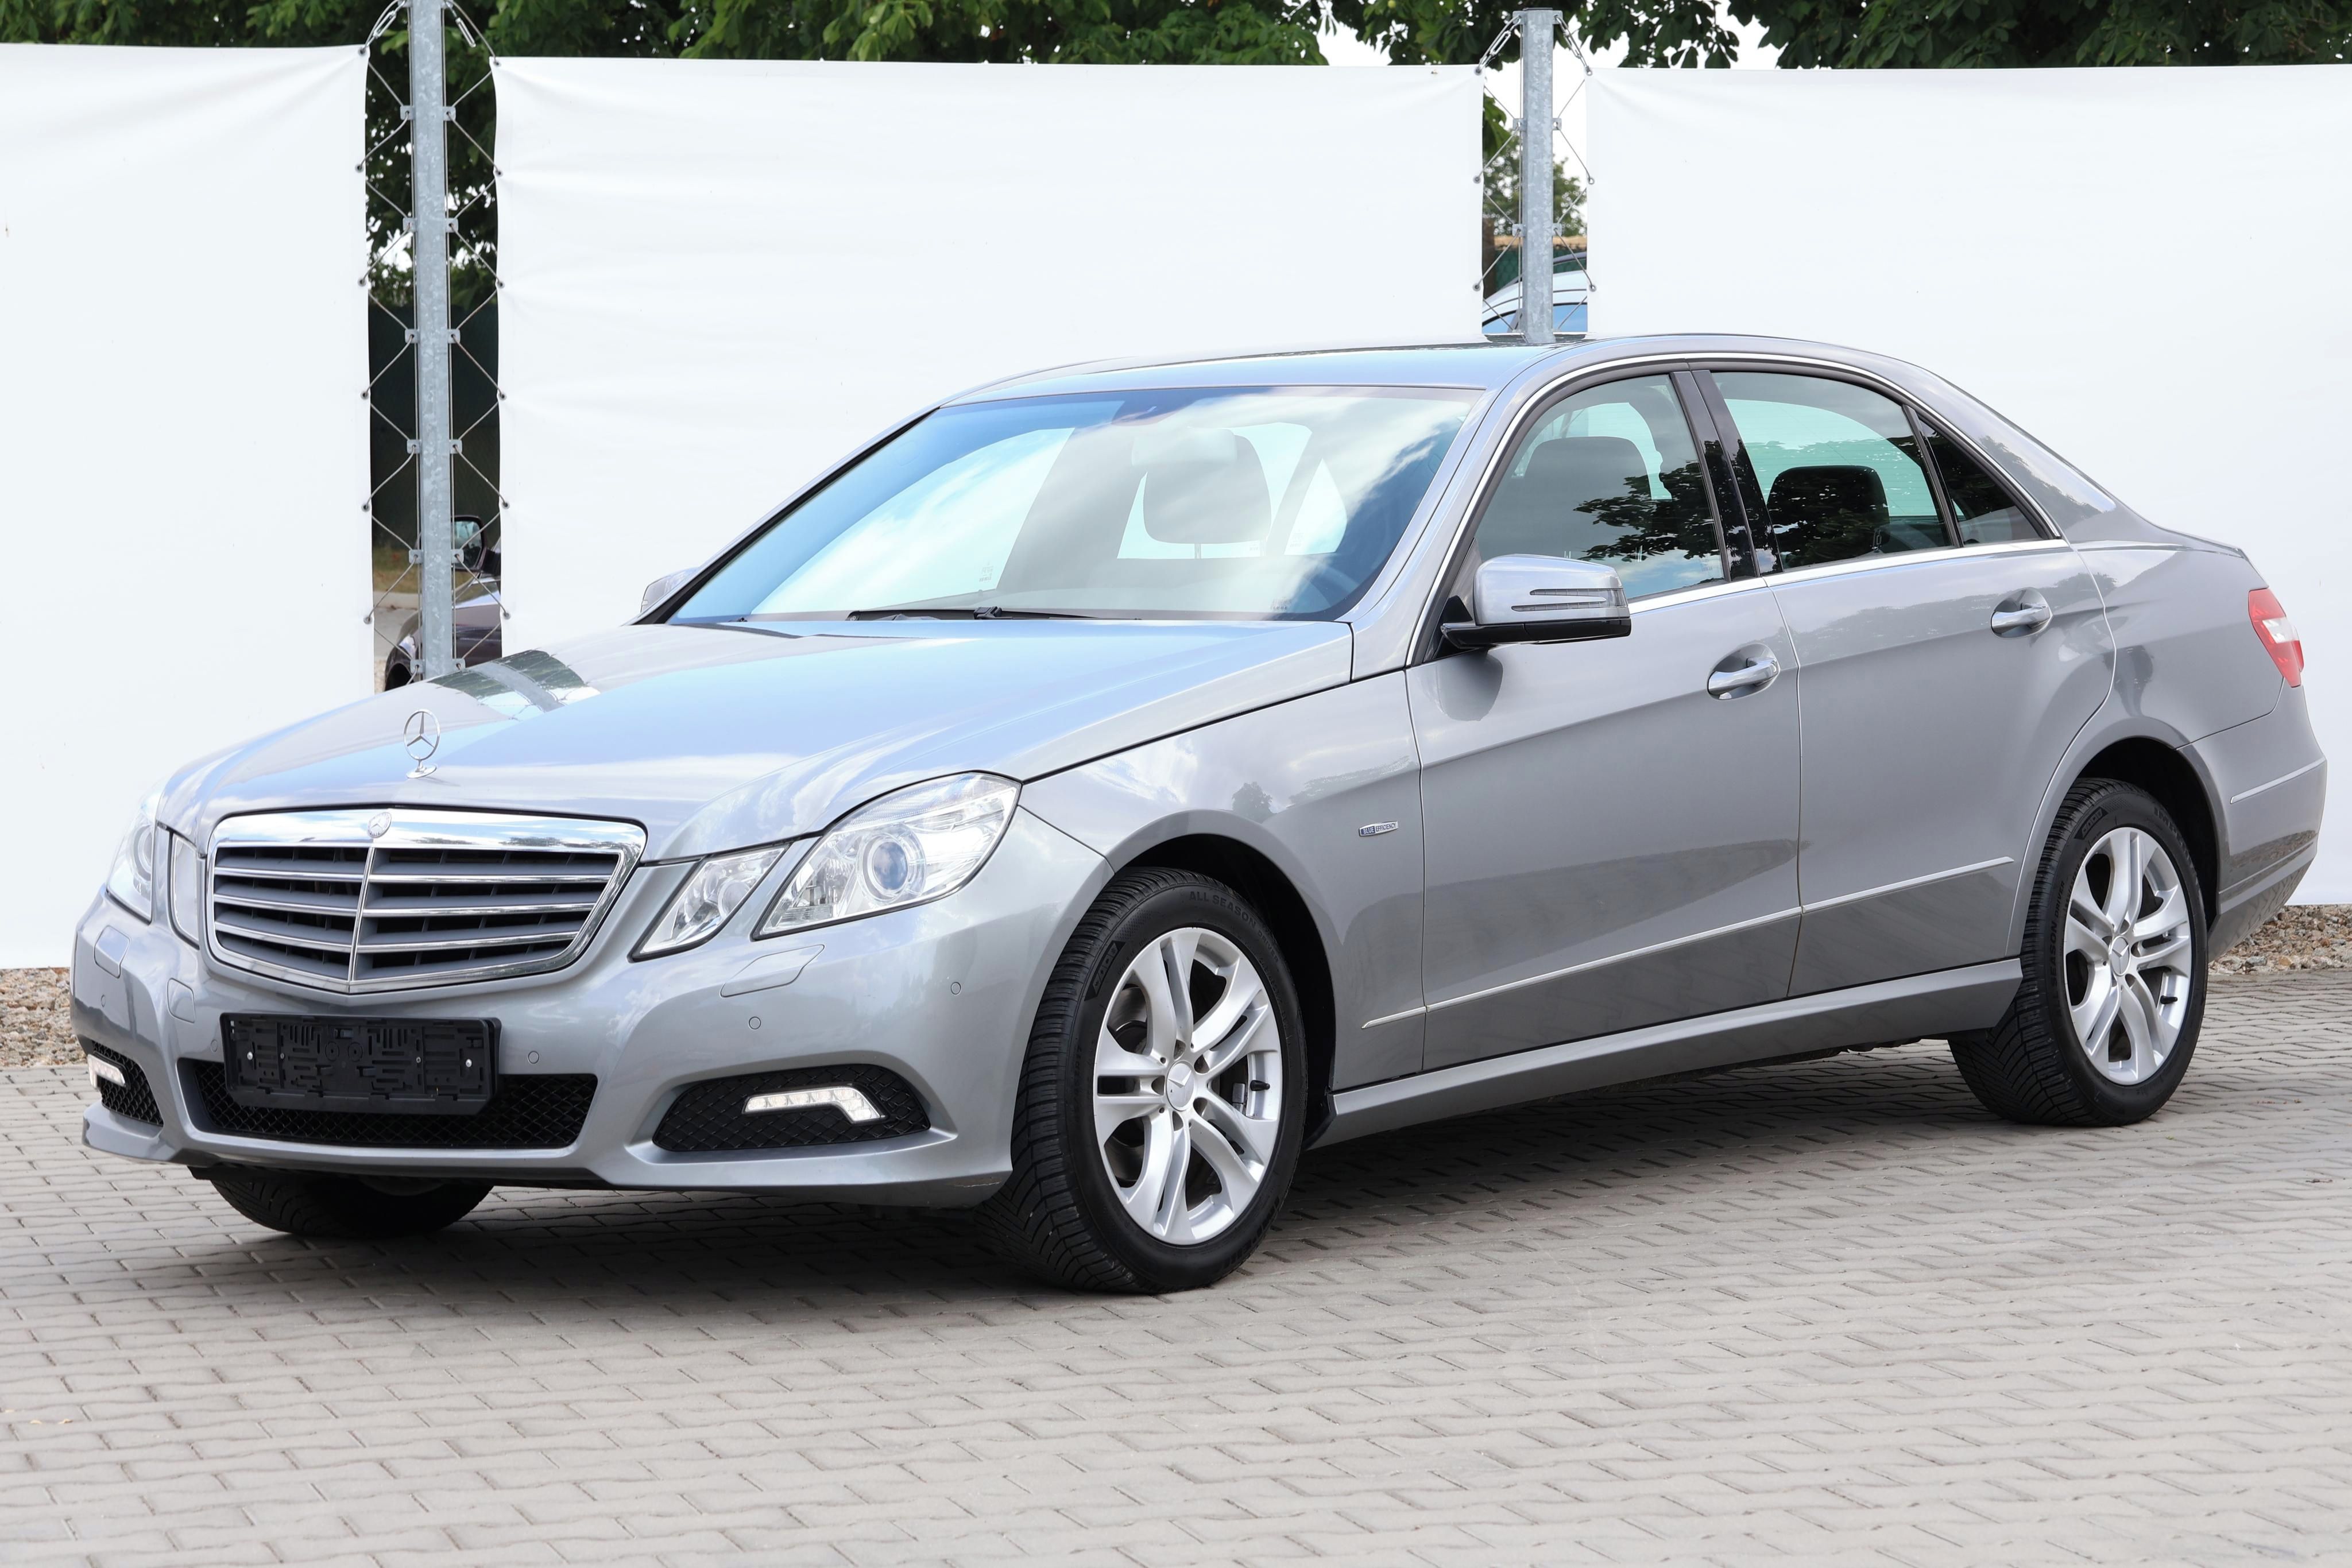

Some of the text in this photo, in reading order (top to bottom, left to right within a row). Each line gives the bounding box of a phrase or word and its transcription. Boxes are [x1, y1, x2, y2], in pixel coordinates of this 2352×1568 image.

[1375, 823, 1396, 832] EFFICIENCY
[1189, 891, 1279, 963] ALL SEASON DRIVER
[2049, 920, 2058, 986] SEASON
[2055, 881, 2065, 917] DRIVER
